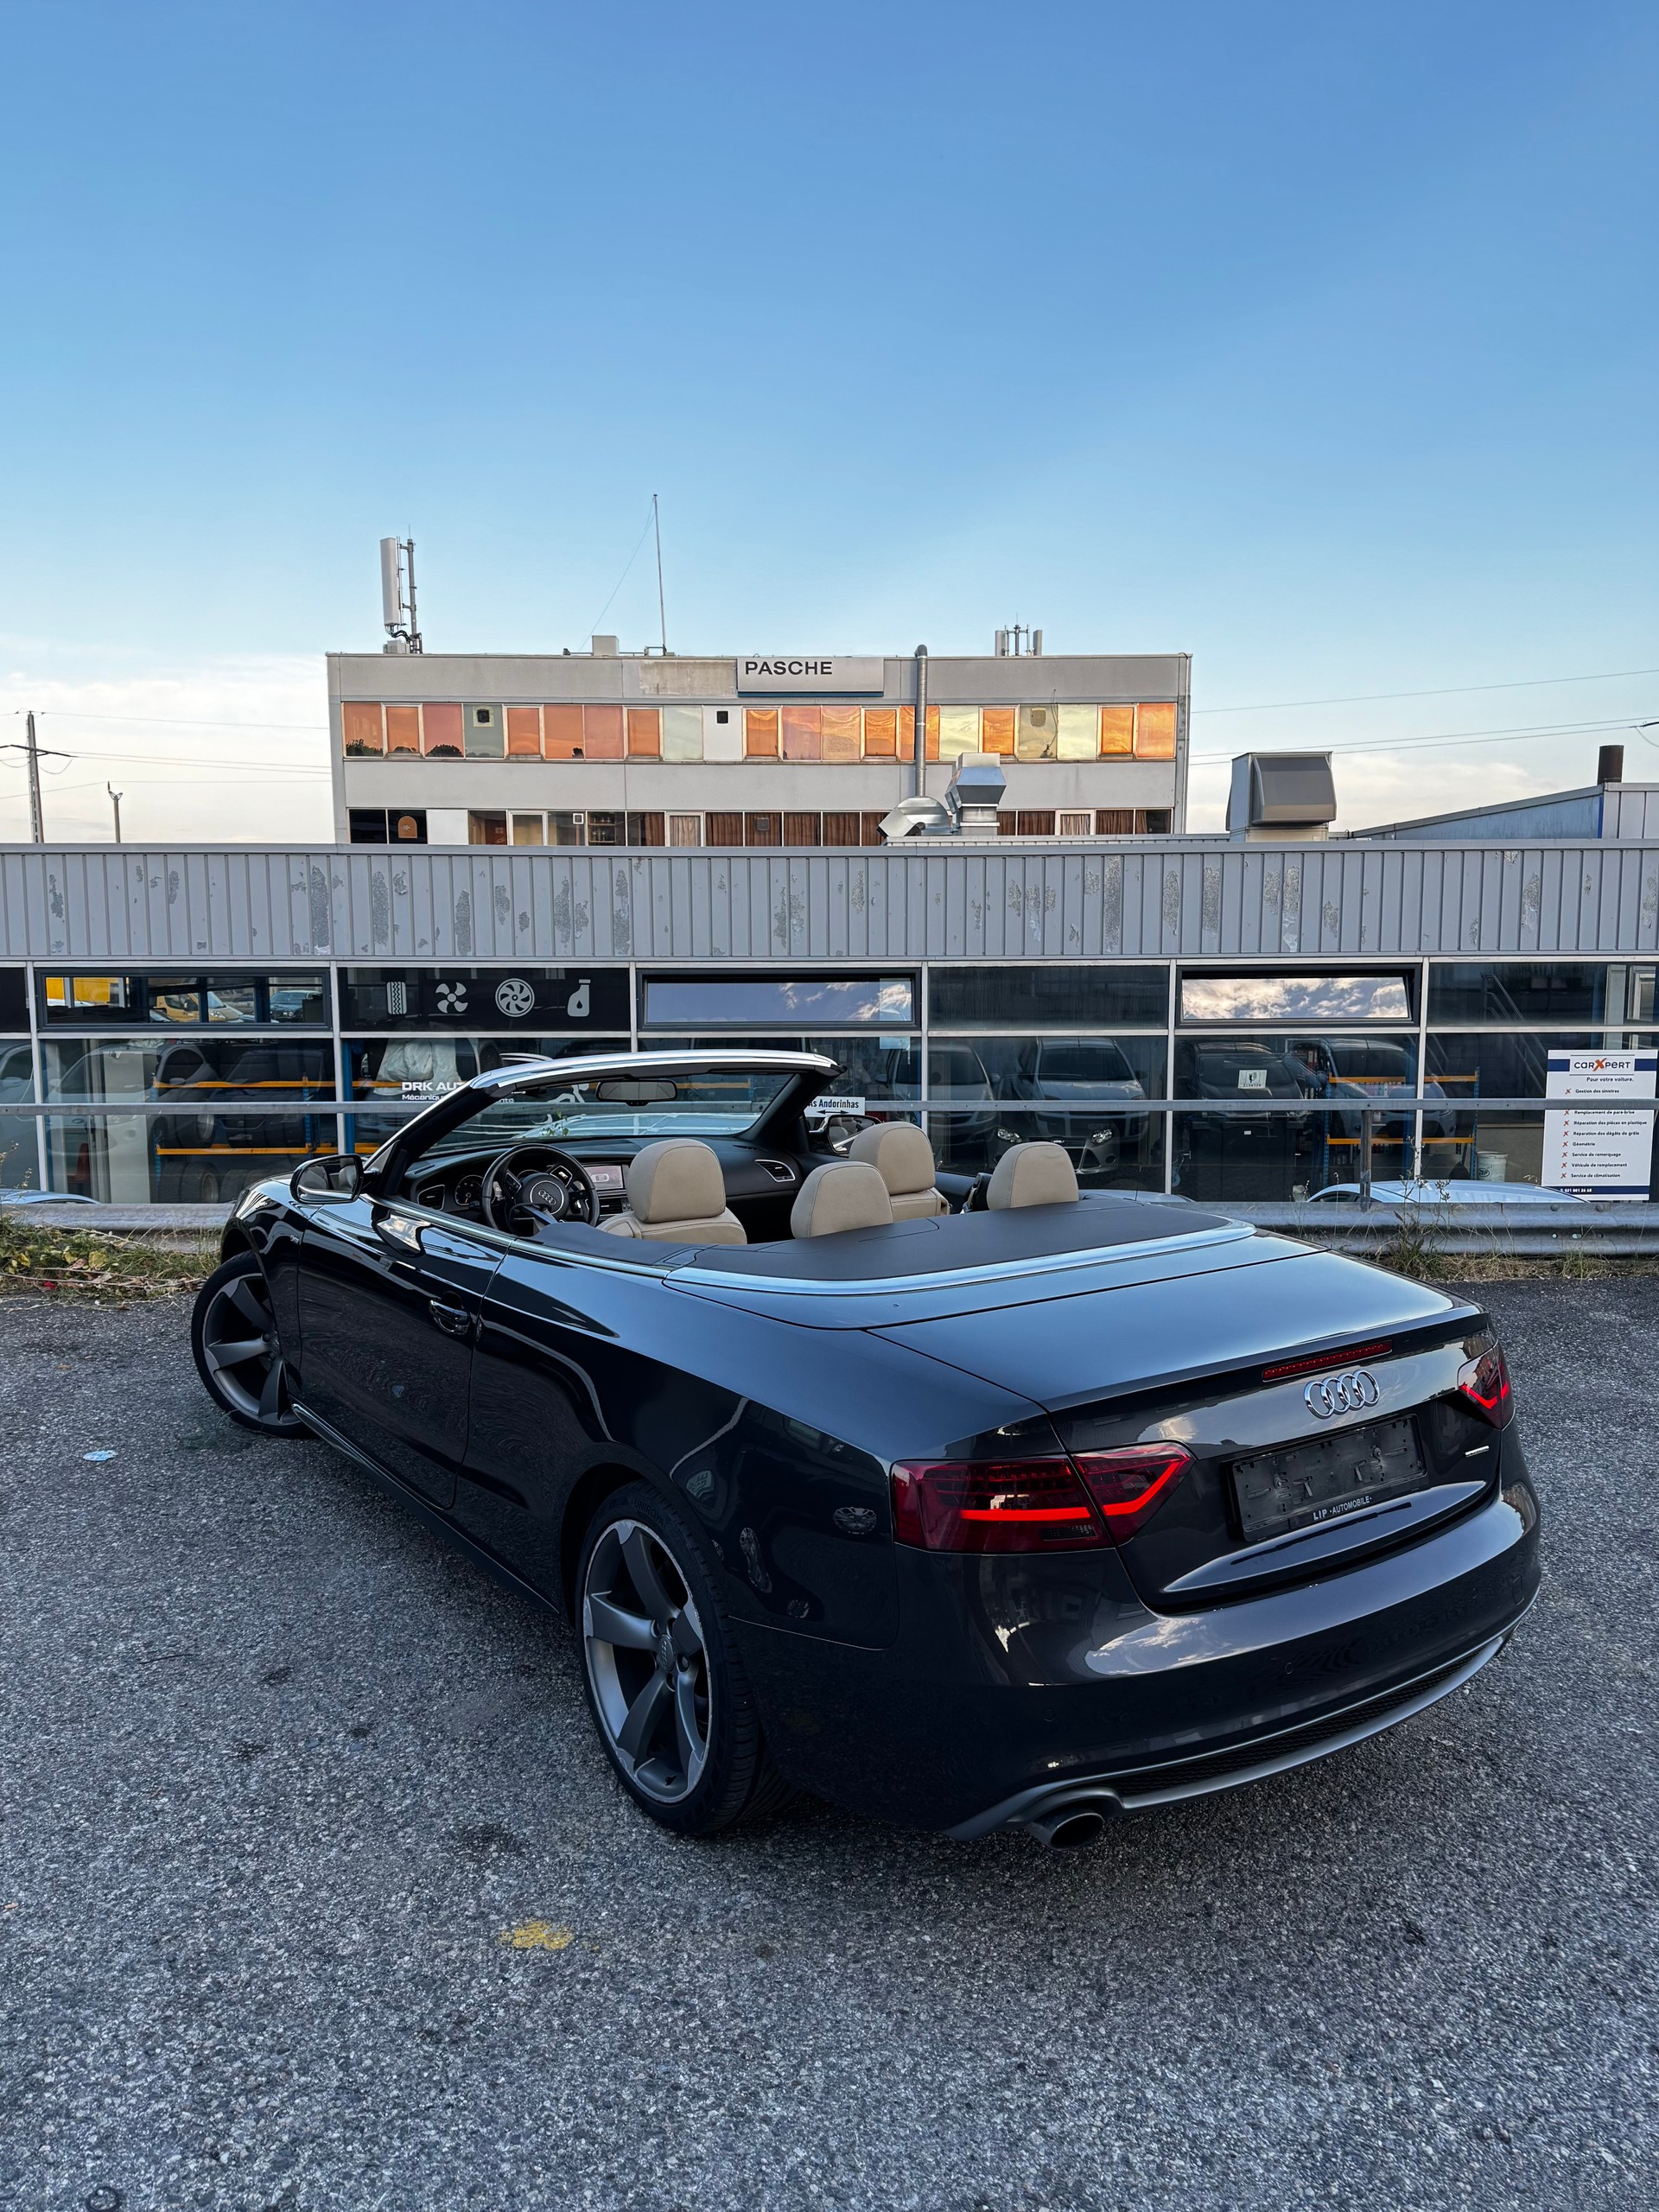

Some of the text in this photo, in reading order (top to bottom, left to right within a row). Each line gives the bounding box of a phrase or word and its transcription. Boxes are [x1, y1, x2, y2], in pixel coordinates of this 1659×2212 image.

[745, 661, 833, 675] PASCHE
[401, 1082, 434, 1091] DRK
[818, 1099, 860, 1109] Andorinhas
[1313, 1509, 1327, 1521] LIP
